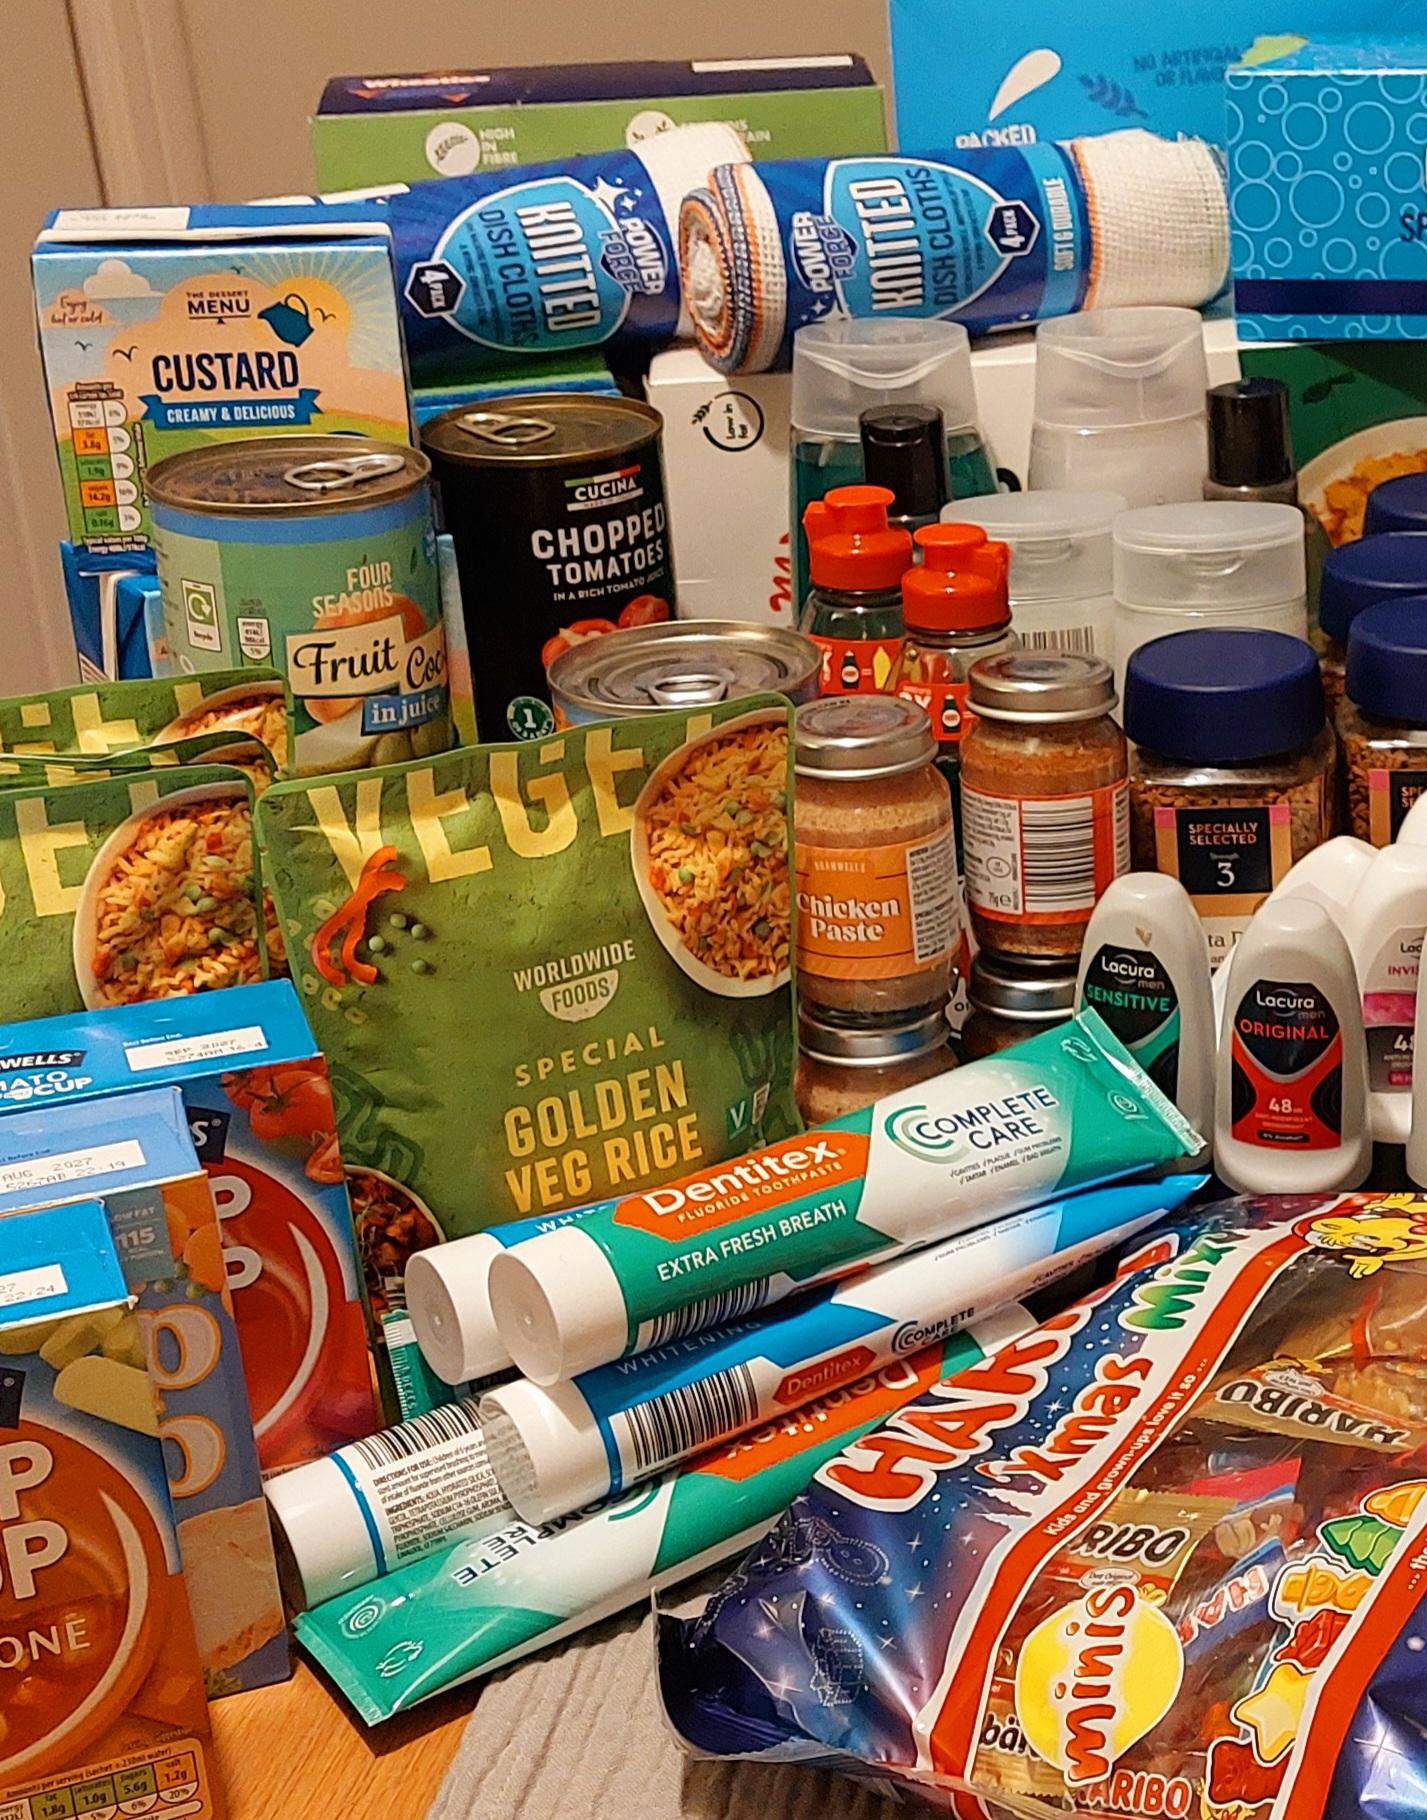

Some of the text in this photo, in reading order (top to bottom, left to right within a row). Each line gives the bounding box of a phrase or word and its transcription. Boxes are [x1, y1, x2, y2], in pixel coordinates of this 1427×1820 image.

[624, 217, 666, 295] POWER
[792, 211, 833, 293] POWER
[813, 215, 856, 280] FORCE
[849, 177, 923, 311] KNITTED
[906, 167, 959, 306] DISH CLOTHS
[479, 209, 540, 345] DISH CLOTHS
[516, 201, 600, 331] KNITTED
[601, 231, 643, 292] FORCE
[187, 299, 250, 315] MENU
[151, 351, 299, 393] CUSTARD
[166, 403, 296, 424] CREAMY & DELICIOUS
[575, 479, 638, 501] CUCINA
[531, 502, 666, 560] CHOPPED
[347, 560, 393, 592] FOUR
[546, 538, 664, 586] TOMATOES
[313, 585, 394, 618] SEASONS
[553, 592, 566, 601] IN
[579, 586, 605, 600] RICH
[607, 578, 645, 595] TOMATO
[293, 637, 399, 685] Fruit
[372, 694, 440, 726] in juice
[1188, 821, 1259, 836] SPECIALLY
[1189, 833, 1258, 846] SELECTED
[1217, 861, 1236, 888] 3
[796, 892, 900, 919] Chicken
[810, 917, 886, 944] Paste
[513, 938, 637, 992] WORLDWIDE
[1101, 955, 1156, 980] Lacura
[1136, 978, 1166, 991] men
[551, 974, 612, 1013] FOODS
[1083, 983, 1171, 1013] SENSITIVE
[1256, 989, 1315, 1011] Lacura
[1239, 1018, 1330, 1041] ORIGINAL
[514, 1027, 666, 1087] SPECIAL
[34, 1076, 93, 1096] CUP
[1269, 1097, 1293, 1114] 48
[504, 1059, 689, 1158] GOLDEN
[914, 1087, 1057, 1142] COMPLETE
[969, 1116, 1044, 1150] CARE
[2, 1156, 93, 1183] AUG 2027
[505, 1113, 703, 1215] VEG RICE
[641, 1139, 842, 1217] Dentitex
[677, 1159, 844, 1223] FLUORIDE TOOTHPASTE
[656, 1198, 848, 1282] EXTRA FRESH BREATH
[903, 1306, 975, 1346] COMPLETE
[617, 1321, 763, 1378] WHITENING
[1003, 1354, 1156, 1483] Xmas
[1124, 1244, 1238, 1331] Mix
[787, 1354, 863, 1397] Dentitex
[1217, 1379, 1410, 1447] HARIBO
[1044, 1512, 1077, 1537] Kids
[1074, 1491, 1101, 1514] and
[1096, 1429, 1155, 1496] grown-ups
[1149, 1399, 1173, 1431] love
[1054, 1586, 1137, 1782] minis
[123, 1781, 148, 1796] 5.6g
[164, 1769, 188, 1784] 1.2g
[41, 1802, 67, 1818] 1.8g
[131, 1799, 147, 1811] 6%
